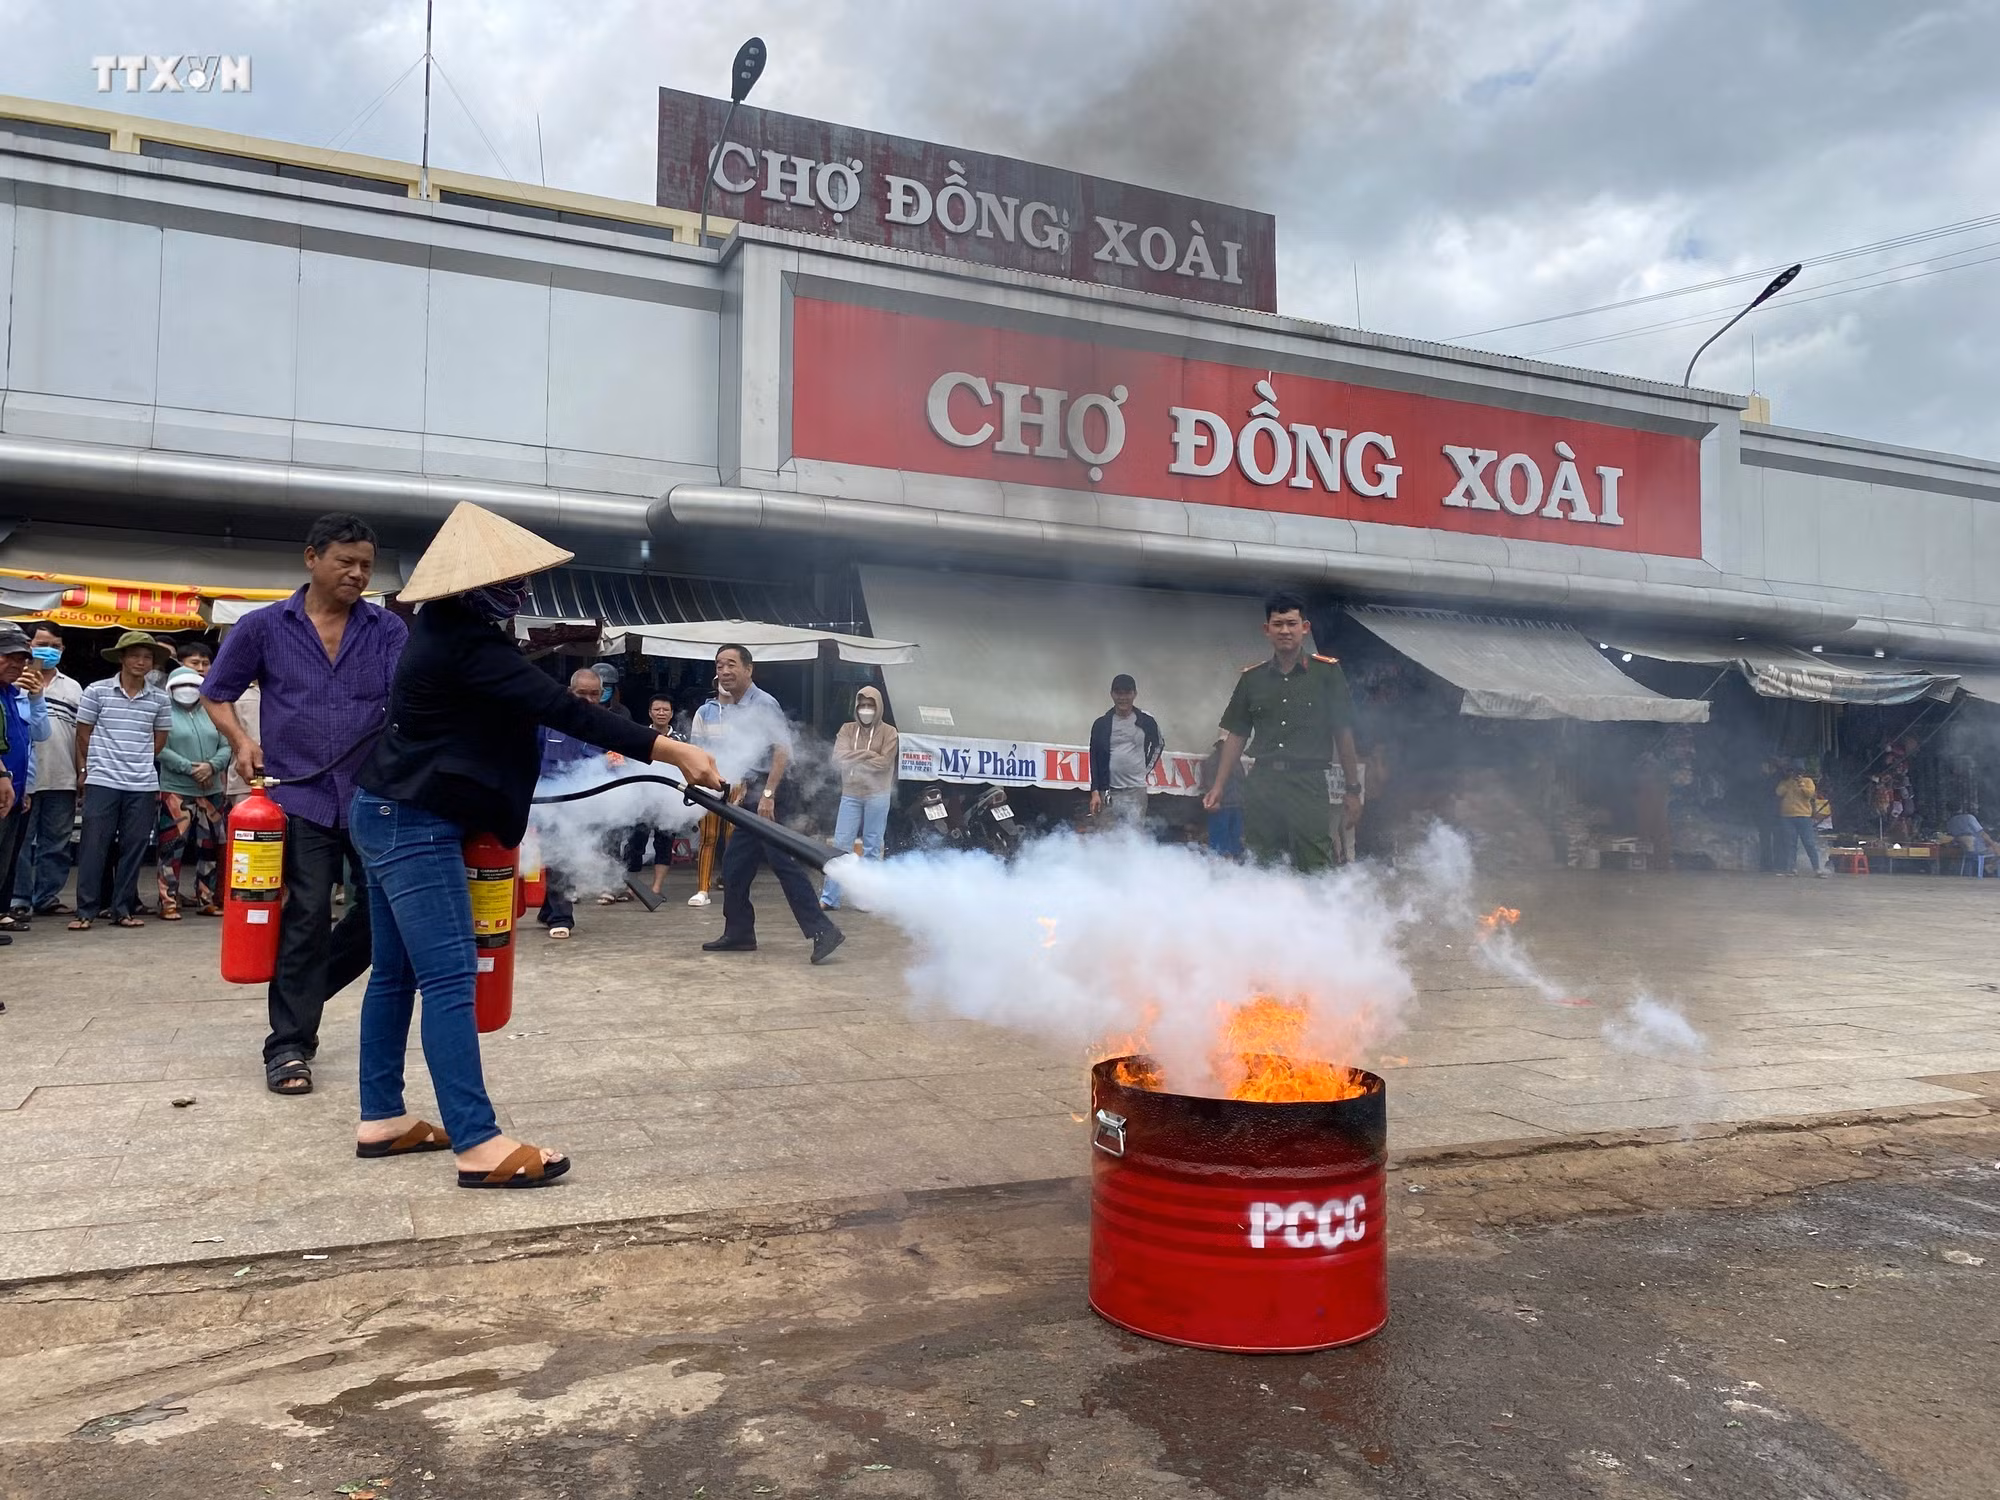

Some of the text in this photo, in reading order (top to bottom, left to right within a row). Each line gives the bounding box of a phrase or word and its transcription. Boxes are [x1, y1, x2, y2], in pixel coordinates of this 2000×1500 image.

[708, 142, 1243, 285] CHỢ ĐỒNG XOÀI
[927, 371, 1625, 526] CHỢ ĐỒNG XOÀI
[938, 748, 971, 779] Mỹ
[977, 744, 1037, 778] Phẩm
[1250, 1194, 1366, 1249] PCCC
